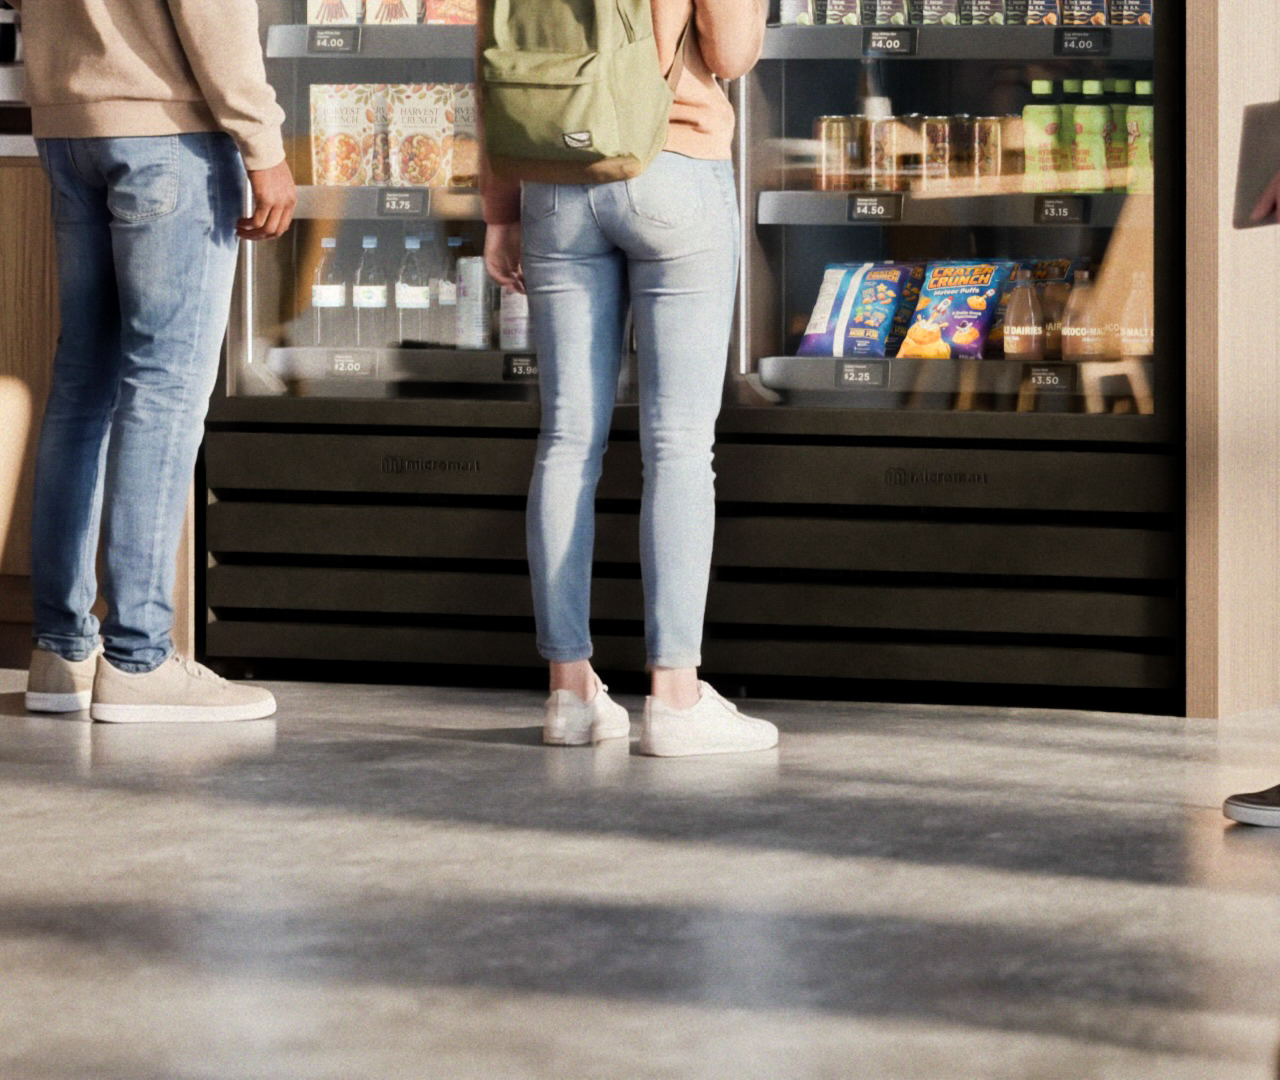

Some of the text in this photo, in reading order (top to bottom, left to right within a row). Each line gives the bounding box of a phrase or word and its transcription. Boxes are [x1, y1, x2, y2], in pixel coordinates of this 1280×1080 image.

[317, 38, 344, 47] $4.00
[871, 40, 900, 49] $4.00
[1064, 40, 1093, 49] $4.00
[400, 107, 439, 116] HARVEST
[401, 115, 438, 124] CRUNCH
[386, 201, 410, 209] $3.75
[856, 206, 885, 215] $4.50
[1044, 208, 1069, 217] $3.15
[932, 264, 996, 278] CRATER
[928, 273, 993, 290] CRUNCH
[1011, 325, 1042, 336] DAIRIES
[334, 362, 361, 371] $2.00
[844, 372, 870, 381] $2.25
[1032, 376, 1059, 385] $3.50
